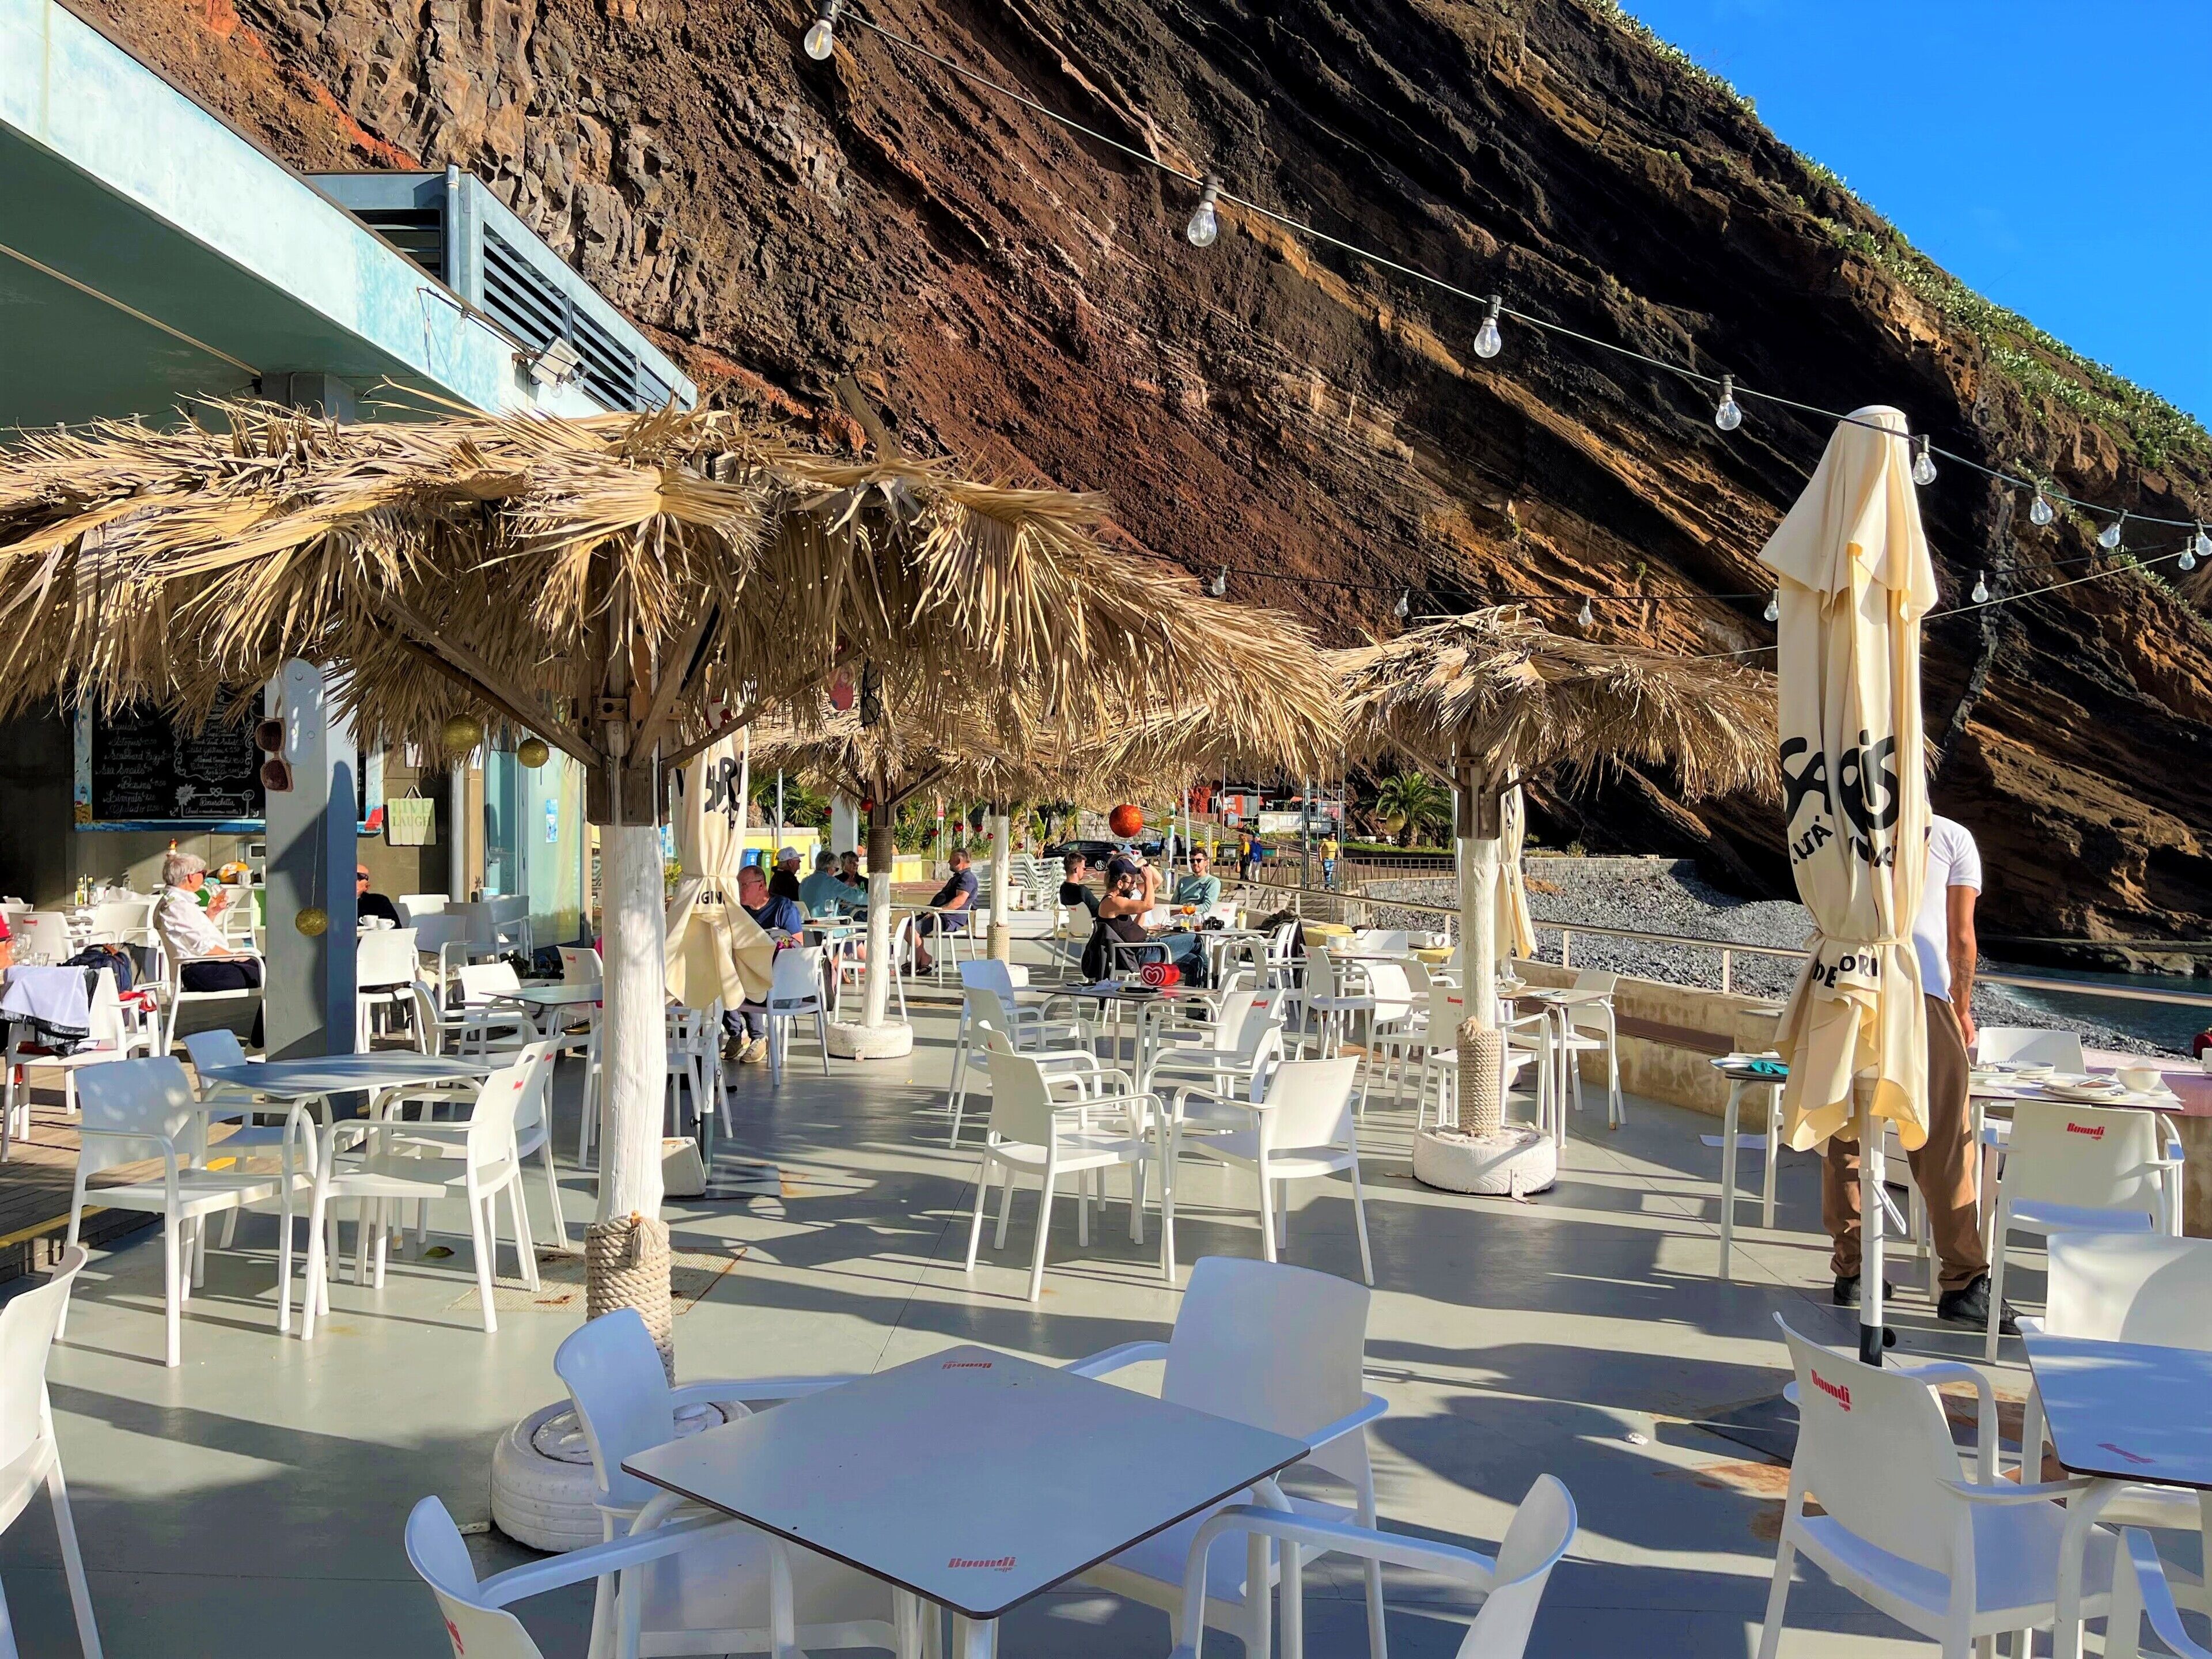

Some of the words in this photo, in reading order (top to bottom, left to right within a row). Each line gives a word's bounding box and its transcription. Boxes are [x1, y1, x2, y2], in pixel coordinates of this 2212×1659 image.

[392, 816, 431, 827] LAUGH
[2066, 1122, 2105, 1136] Buondi
[1810, 1368, 1851, 1403] Buondi
[948, 1556, 1017, 1568] Buondi
